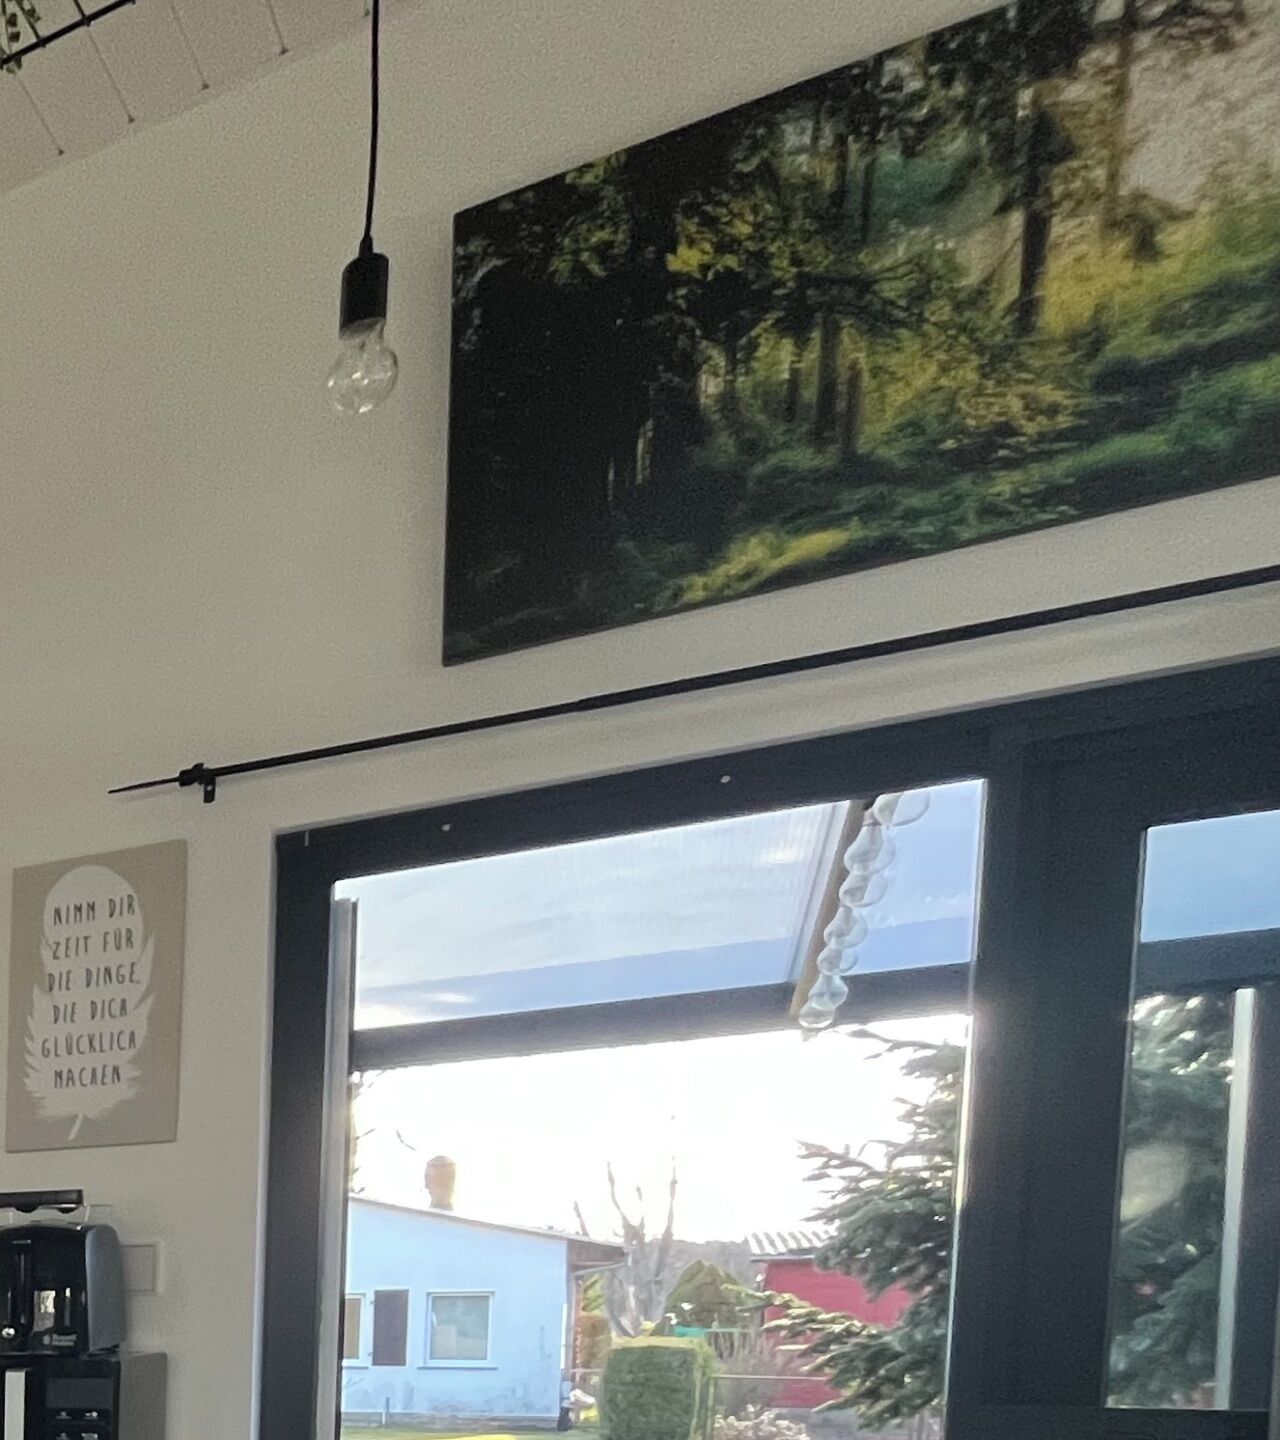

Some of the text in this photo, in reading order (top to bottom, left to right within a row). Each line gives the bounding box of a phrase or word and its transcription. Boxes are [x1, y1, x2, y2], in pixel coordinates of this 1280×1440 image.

[53, 894, 136, 926] NIMM DIR
[52, 927, 134, 960] ZEIT FÜR
[47, 970, 72, 992] DIE
[52, 1002, 76, 1025] DIE
[53, 1064, 121, 1088] MACHEN
